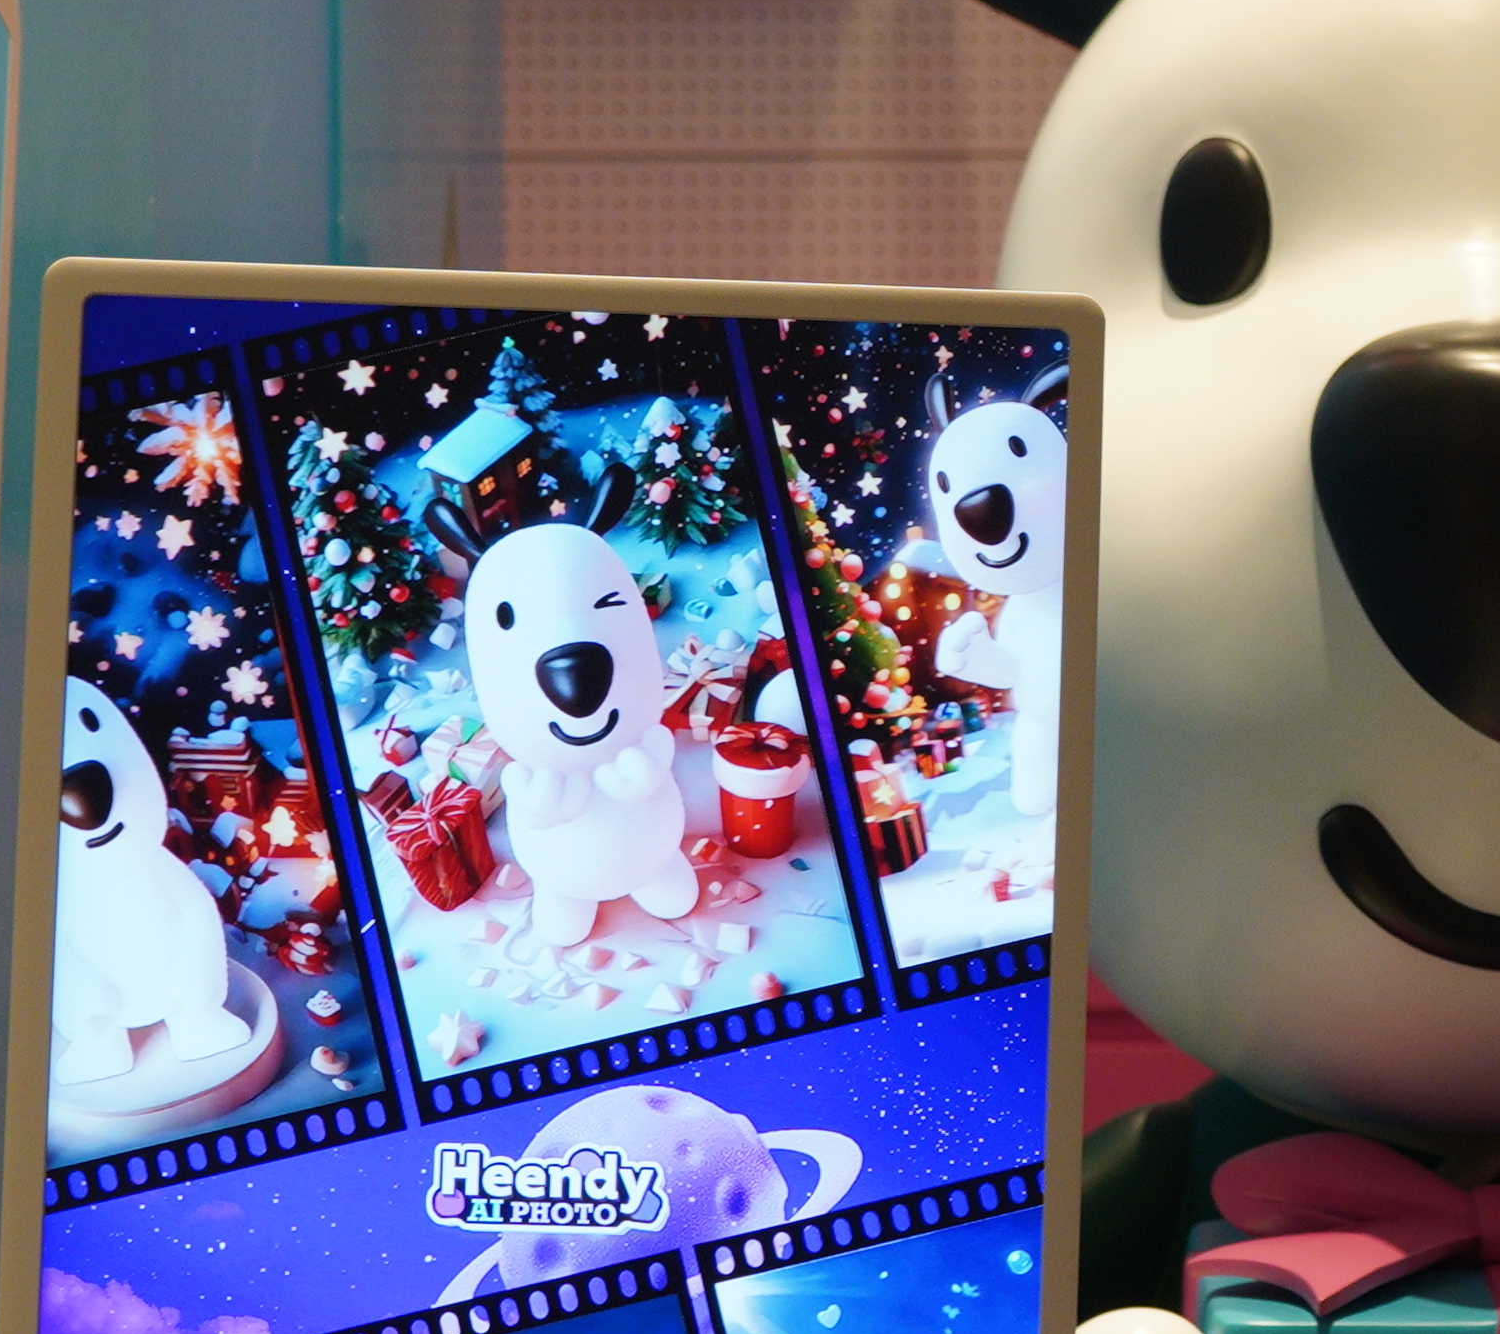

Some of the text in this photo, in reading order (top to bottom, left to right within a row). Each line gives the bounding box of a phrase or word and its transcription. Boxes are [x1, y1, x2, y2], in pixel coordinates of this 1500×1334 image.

[440, 1149, 655, 1214] Heendy
[467, 1198, 618, 1226] AI PHOTO
